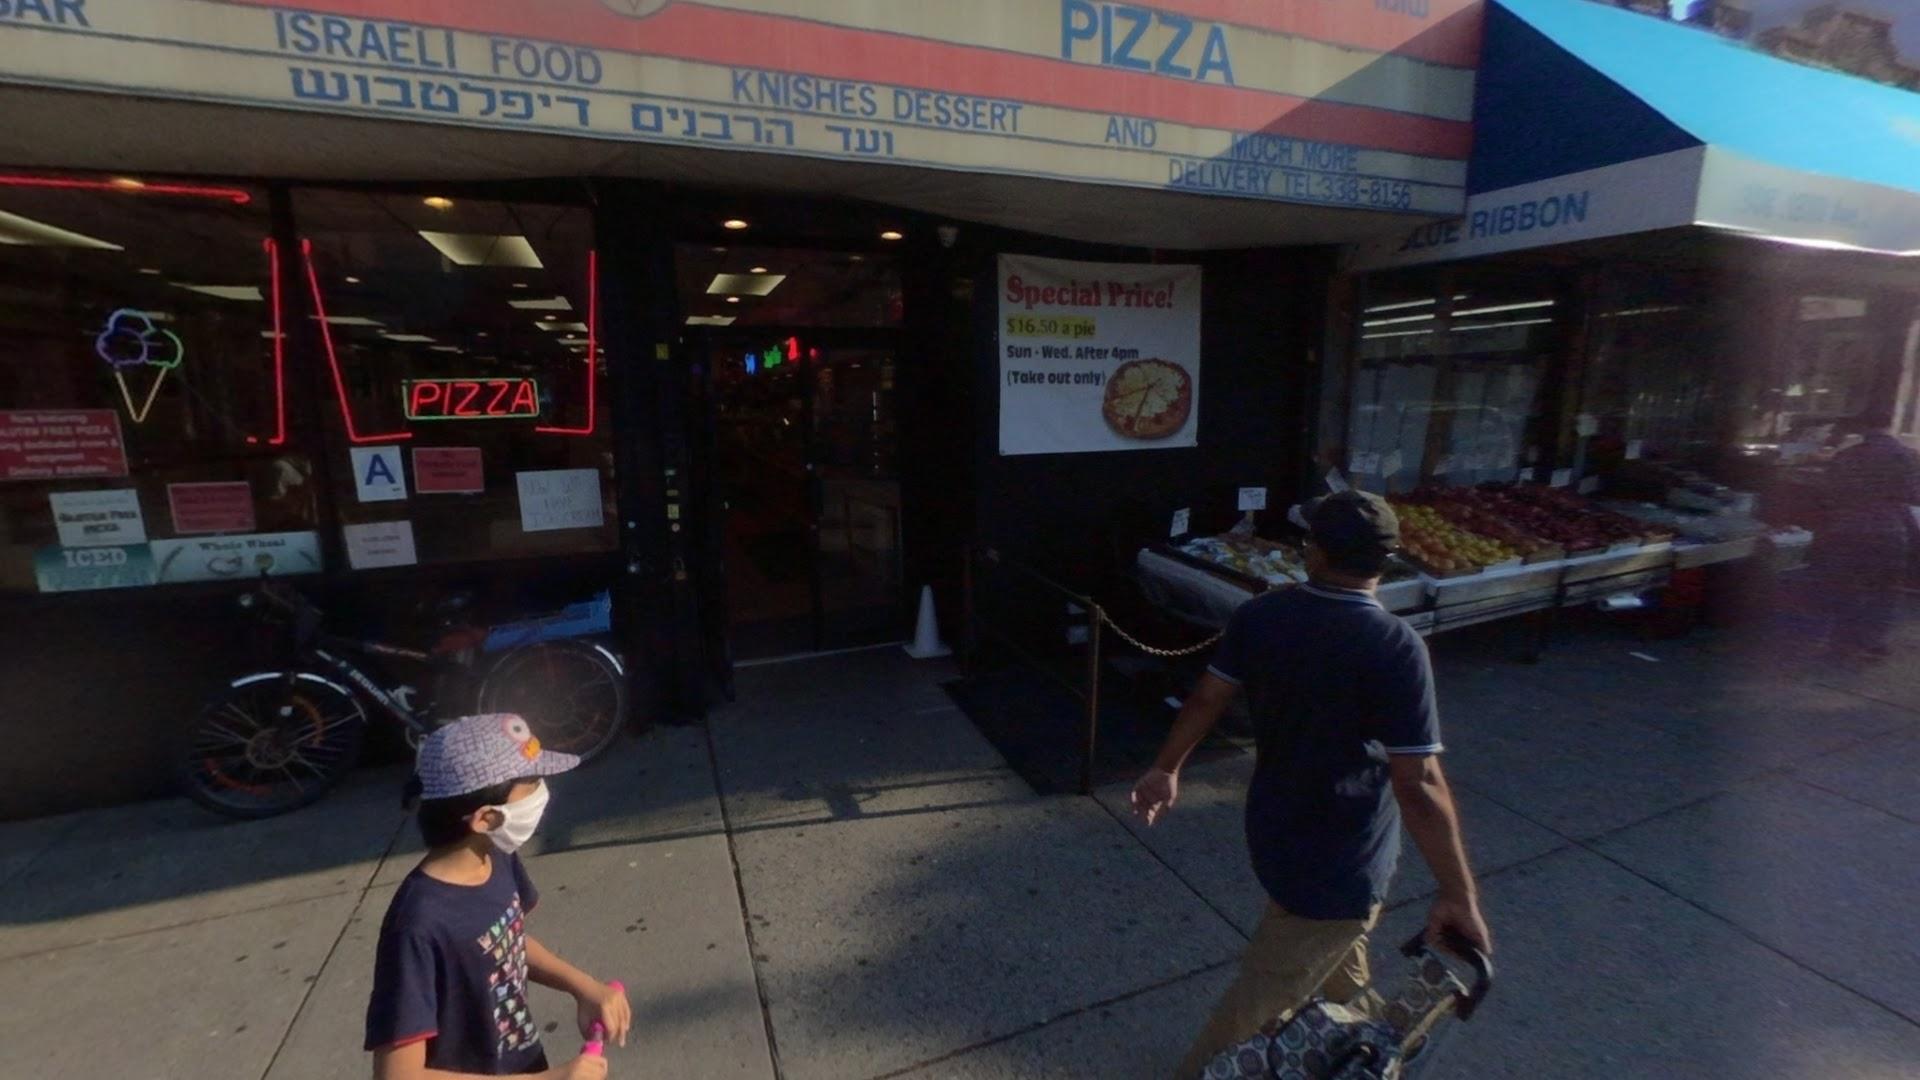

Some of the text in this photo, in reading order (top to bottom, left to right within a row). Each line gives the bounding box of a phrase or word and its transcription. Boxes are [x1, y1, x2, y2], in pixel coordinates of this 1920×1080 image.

[1061, 0, 1235, 85] PIZZA
[274, 12, 1358, 172] ISRAELI FOOD KNISHES DESSERT AND MUCH MORE
[631, 102, 795, 147] הרבנים
[825, 124, 895, 156] ועד
[1168, 158, 1272, 195] DELIVERY
[1469, 190, 1589, 240] RIBBON
[1006, 274, 1175, 310] Special Price!
[1006, 317, 1096, 338] $16.50 a pie
[1006, 344, 1032, 359] Sun
[1041, 345, 1073, 360] Wed.
[1111, 347, 1140, 361] 4pm
[1006, 370, 1107, 388] (Take out only)
[410, 380, 537, 417] PIZZA
[364, 453, 397, 487] A
